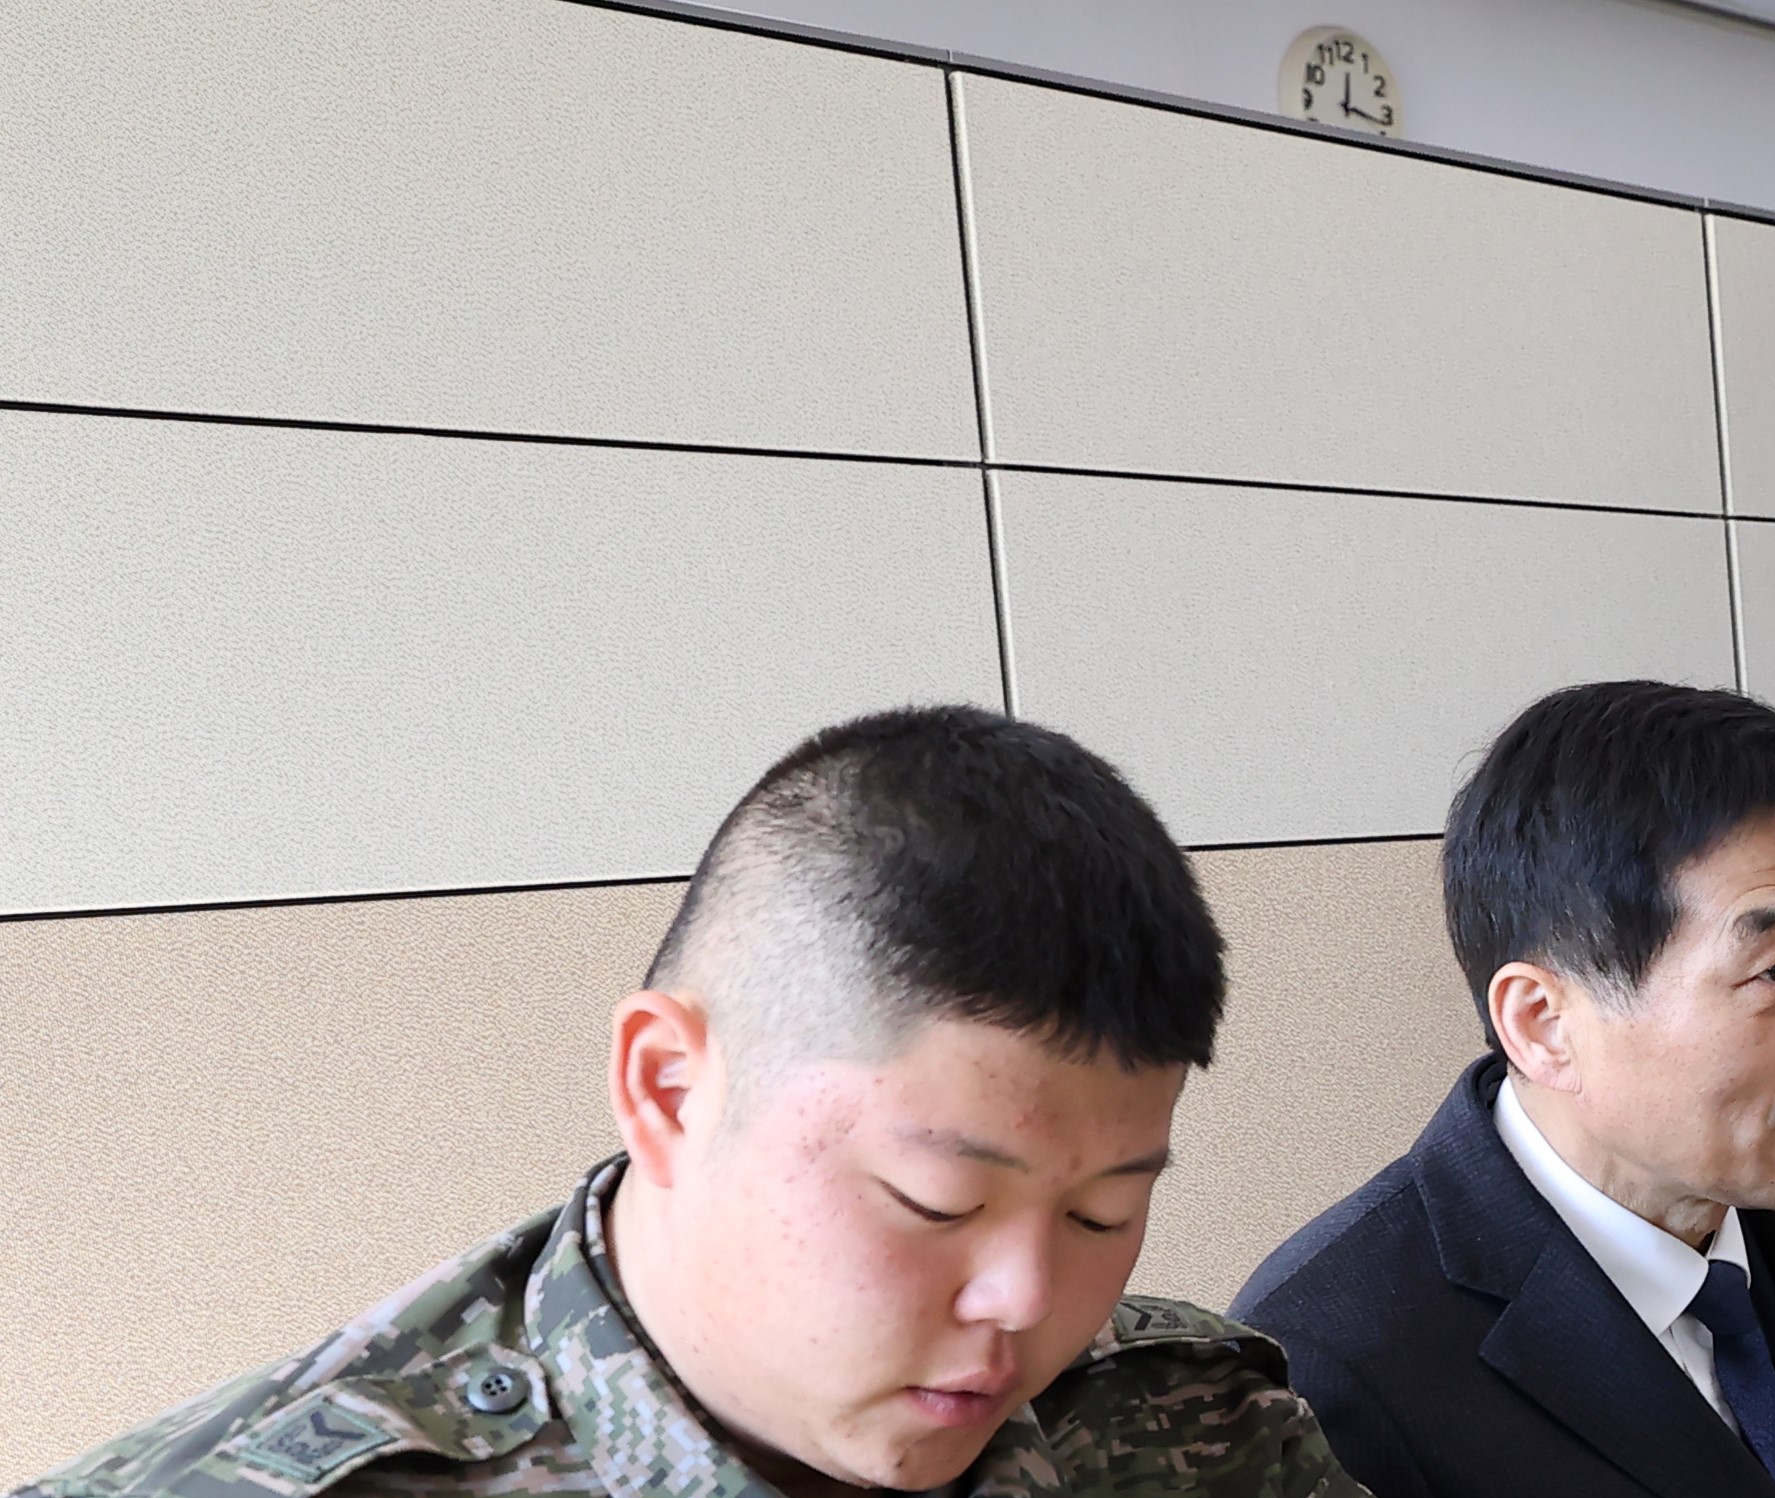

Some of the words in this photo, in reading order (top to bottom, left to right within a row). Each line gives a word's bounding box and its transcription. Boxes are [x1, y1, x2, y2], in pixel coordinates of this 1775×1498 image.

[1317, 43, 1335, 66] 11
[1333, 40, 1355, 64] 12
[1361, 52, 1369, 74] 1
[1305, 62, 1326, 87] 10
[1373, 75, 1386, 98] 2
[1380, 104, 1394, 126] 3
